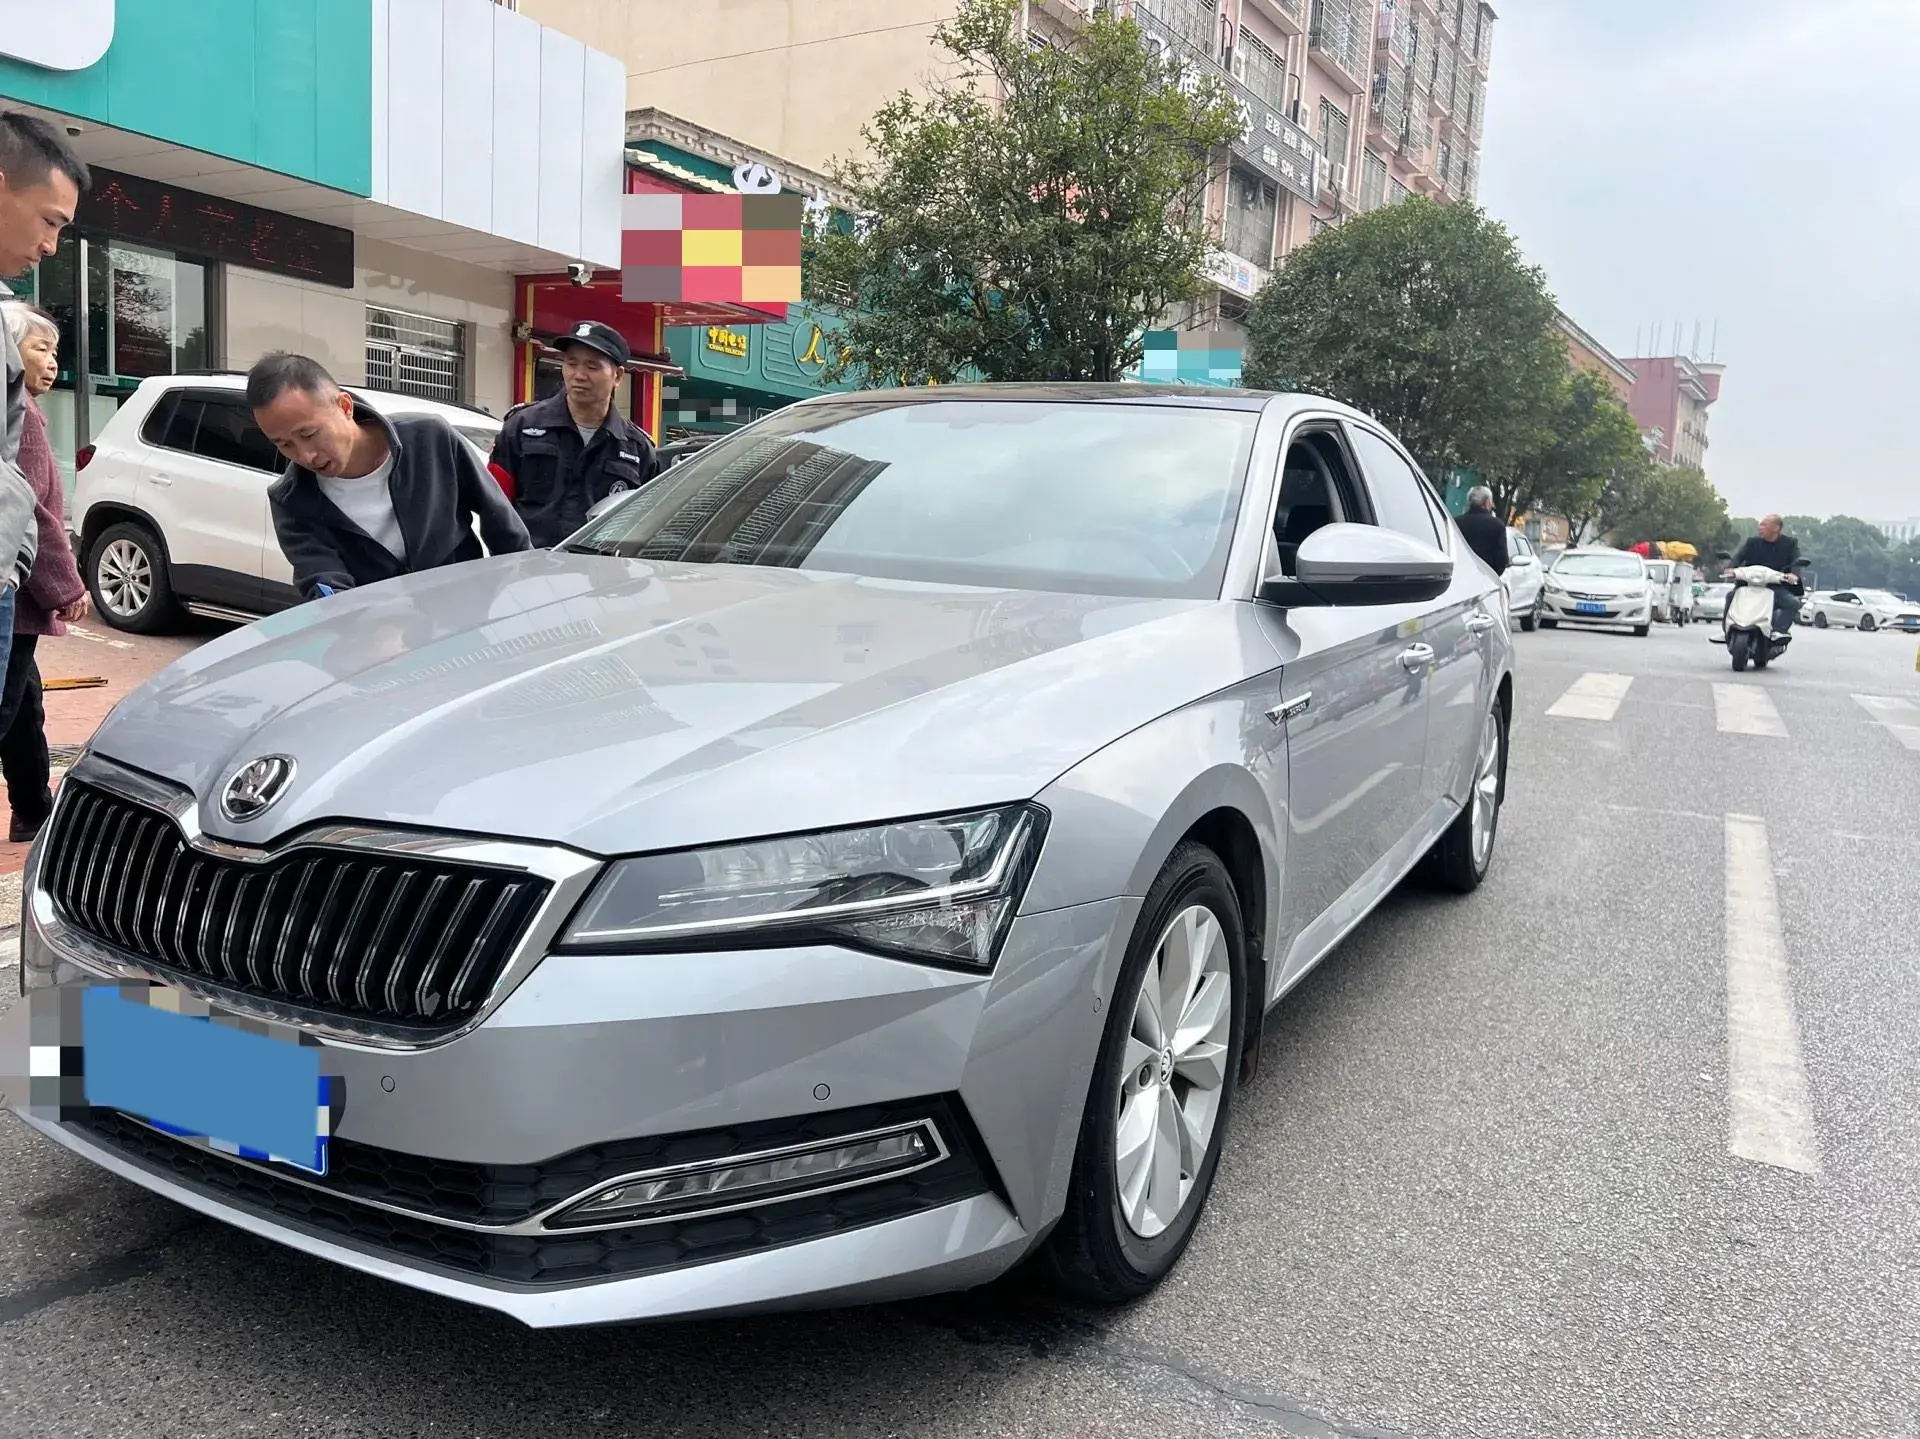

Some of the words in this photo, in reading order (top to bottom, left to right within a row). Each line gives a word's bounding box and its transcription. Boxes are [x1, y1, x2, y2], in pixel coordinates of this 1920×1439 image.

[1281, 159, 1294, 180] SPA
[708, 326, 747, 349] 中国电信
